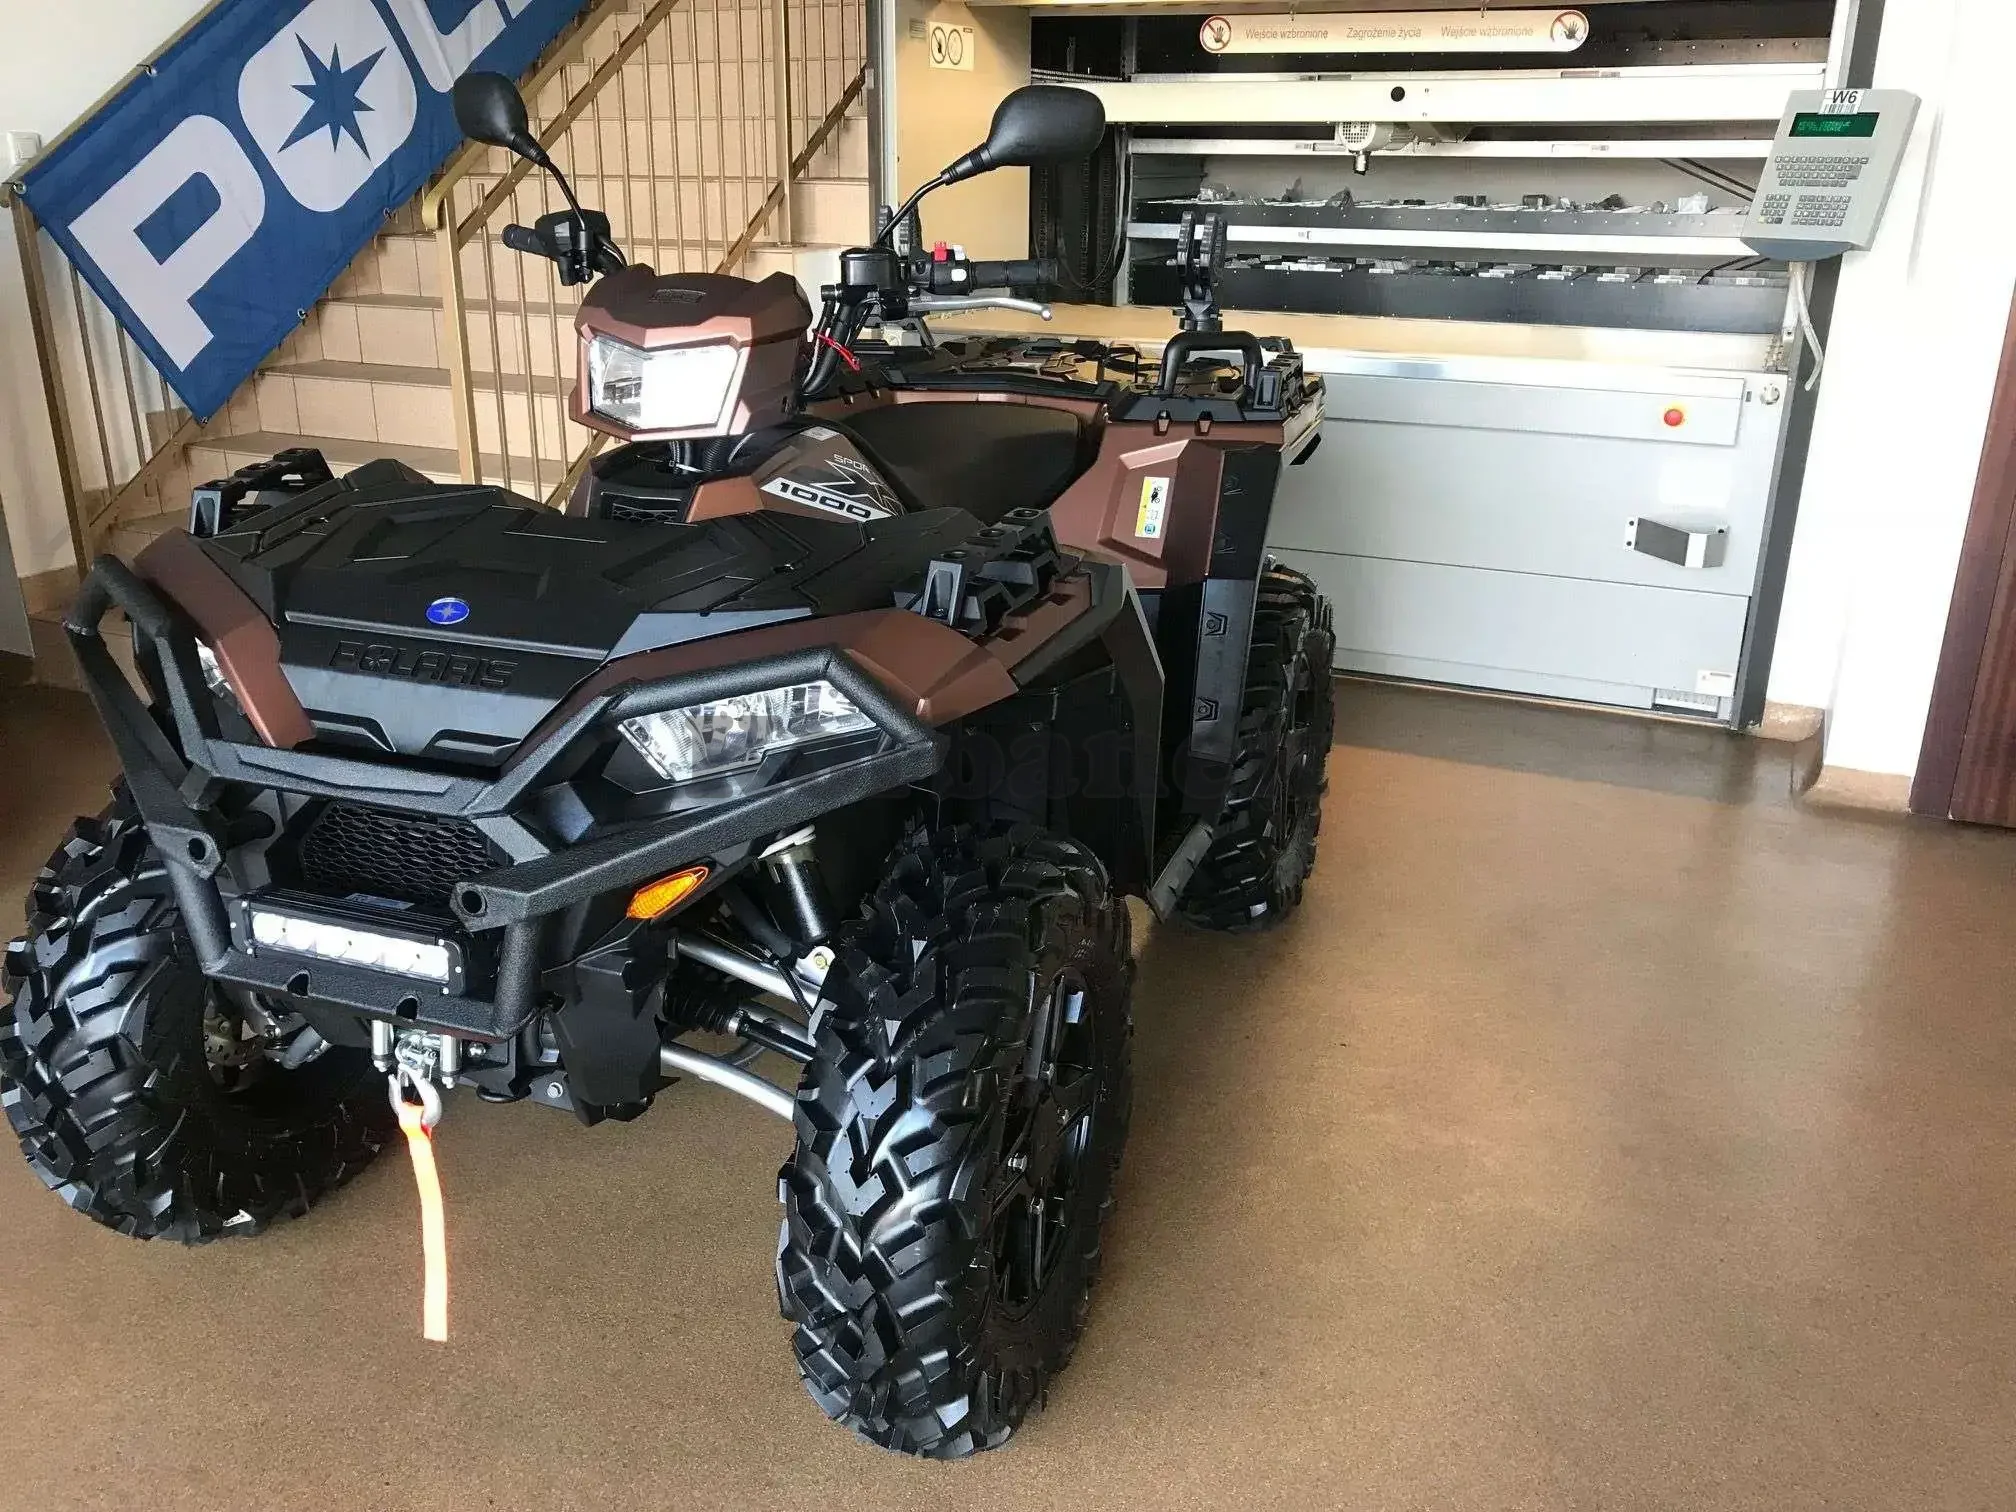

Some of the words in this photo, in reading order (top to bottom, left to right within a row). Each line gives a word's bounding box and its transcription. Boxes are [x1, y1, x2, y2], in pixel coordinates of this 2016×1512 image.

[1346, 27, 1397, 41] Zagrożenie
[1398, 27, 1422, 41] życia
[1832, 90, 1859, 104] W6
[67, 0, 534, 372] POL
[779, 481, 872, 519] 1000
[329, 640, 519, 690] POLARIS
